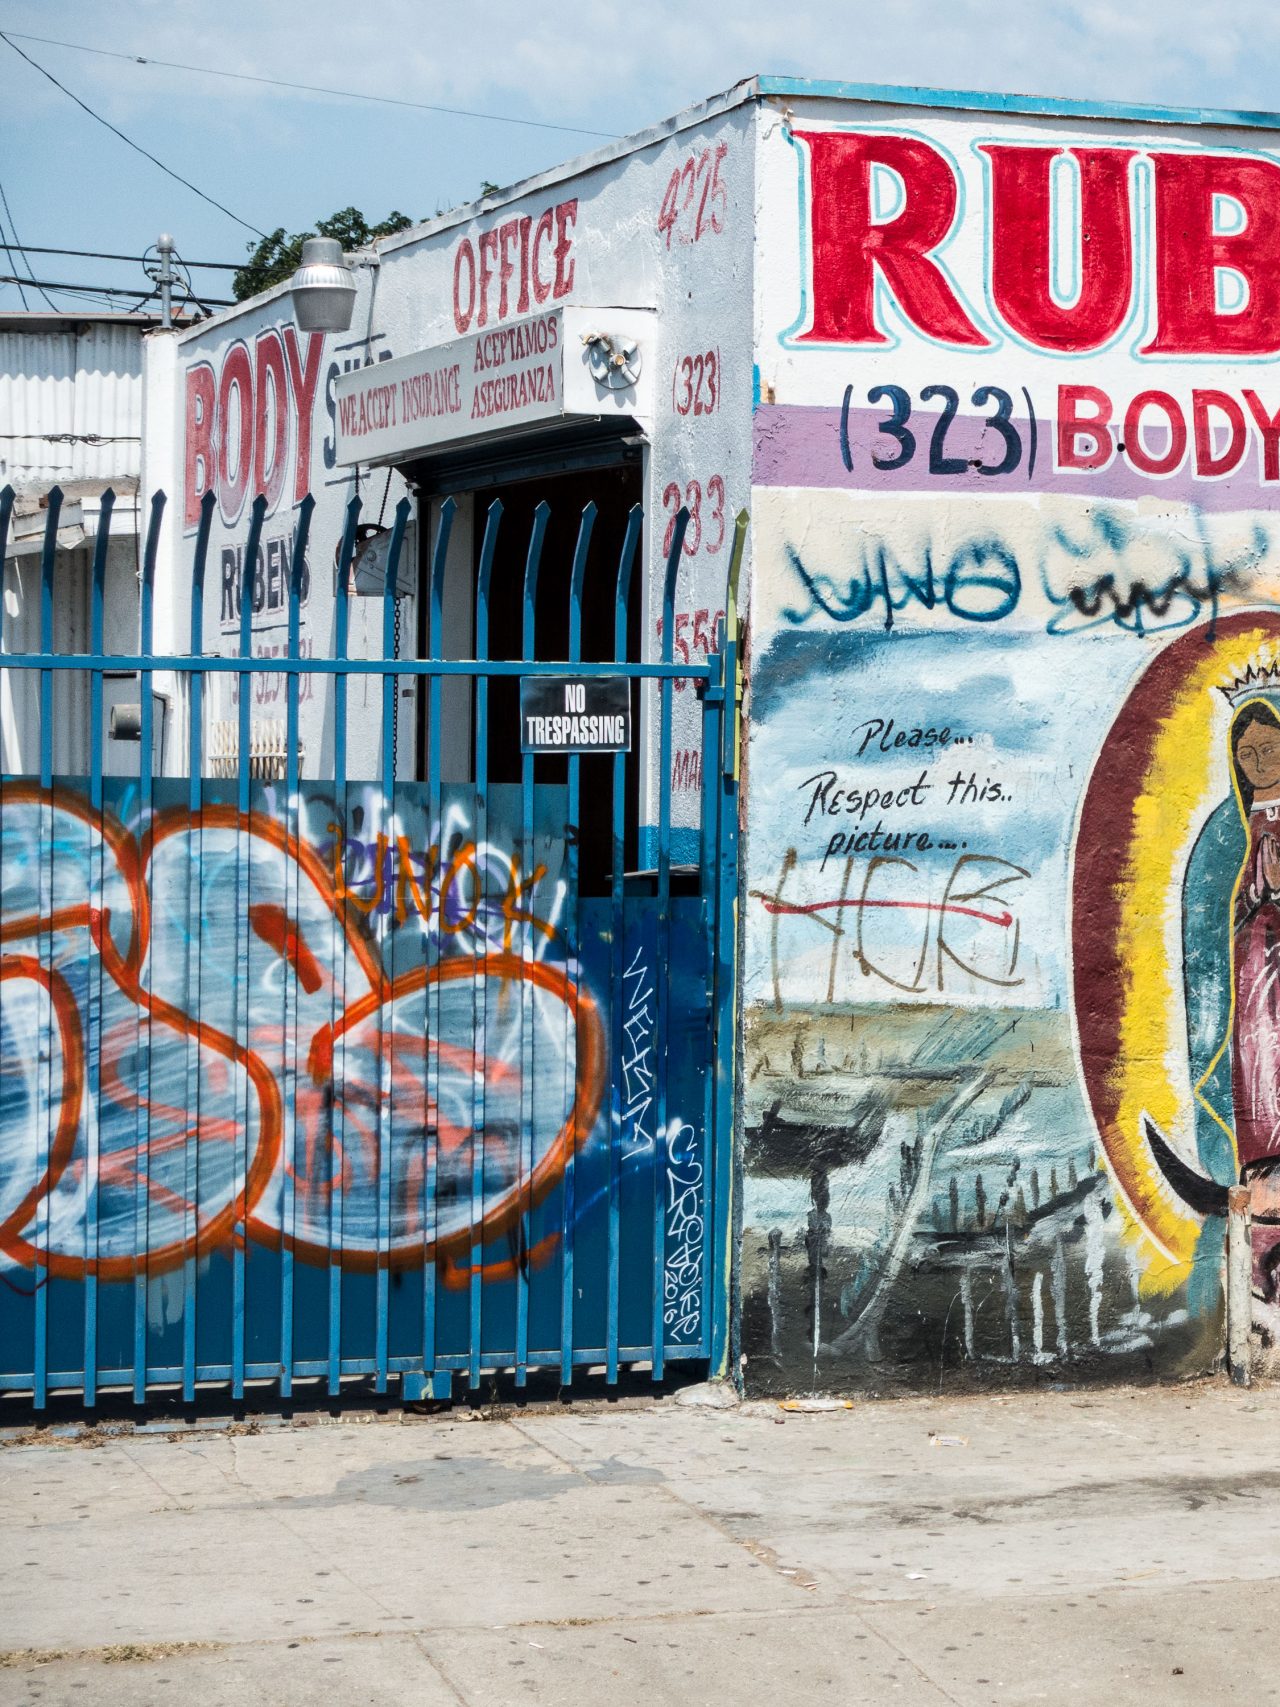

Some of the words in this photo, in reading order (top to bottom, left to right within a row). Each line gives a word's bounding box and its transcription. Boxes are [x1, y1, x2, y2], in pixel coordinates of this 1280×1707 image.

[453, 198, 579, 334] OFFICE
[474, 316, 558, 374] ACEPTAMOS
[338, 393, 358, 437] WE
[358, 383, 398, 436] ACCEPT
[401, 364, 462, 424] INSURANCE
[470, 363, 556, 420] ASEGURANZA
[672, 345, 721, 416] (323)
[182, 325, 326, 531] BODY
[839, 383, 1038, 481] (323)
[526, 715, 625, 745] TRESPASSING
[565, 683, 586, 713] NO
[664, 1269, 678, 1324] 2016
